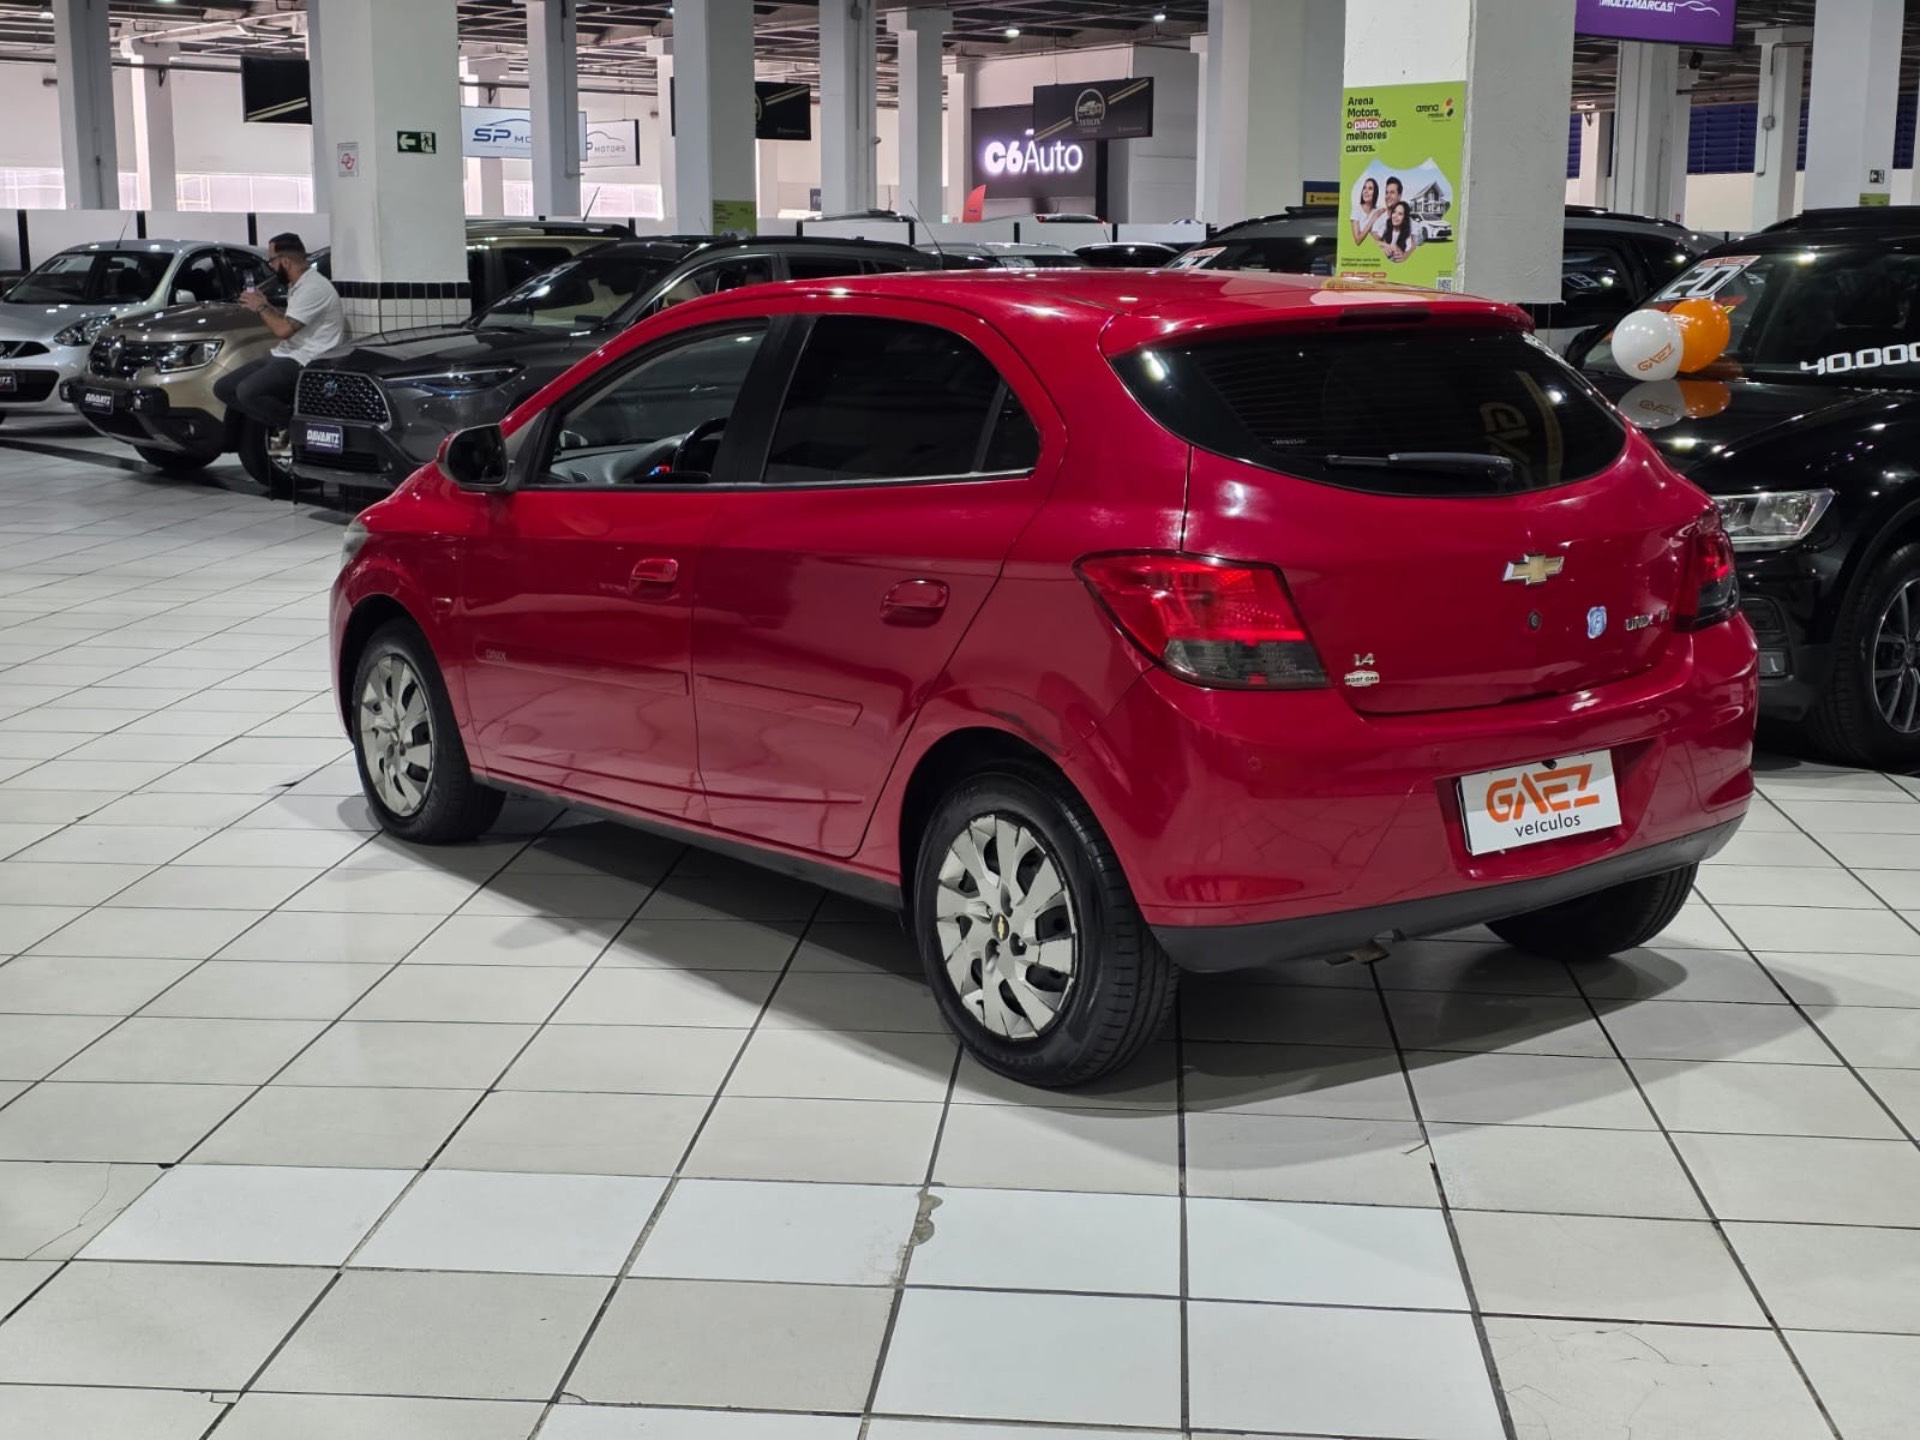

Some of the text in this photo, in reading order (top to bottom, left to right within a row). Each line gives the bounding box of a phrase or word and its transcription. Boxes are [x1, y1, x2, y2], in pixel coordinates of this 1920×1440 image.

[1347, 97, 1374, 106] Arena
[1347, 108, 1381, 118] Motors,
[1354, 119, 1379, 130] palco
[1380, 118, 1397, 128] dos
[472, 128, 512, 142] SP
[1346, 130, 1387, 141] melhores
[1345, 144, 1376, 153] carros.
[1486, 763, 1600, 823] GAEZ
[1514, 812, 1581, 838] veículos
